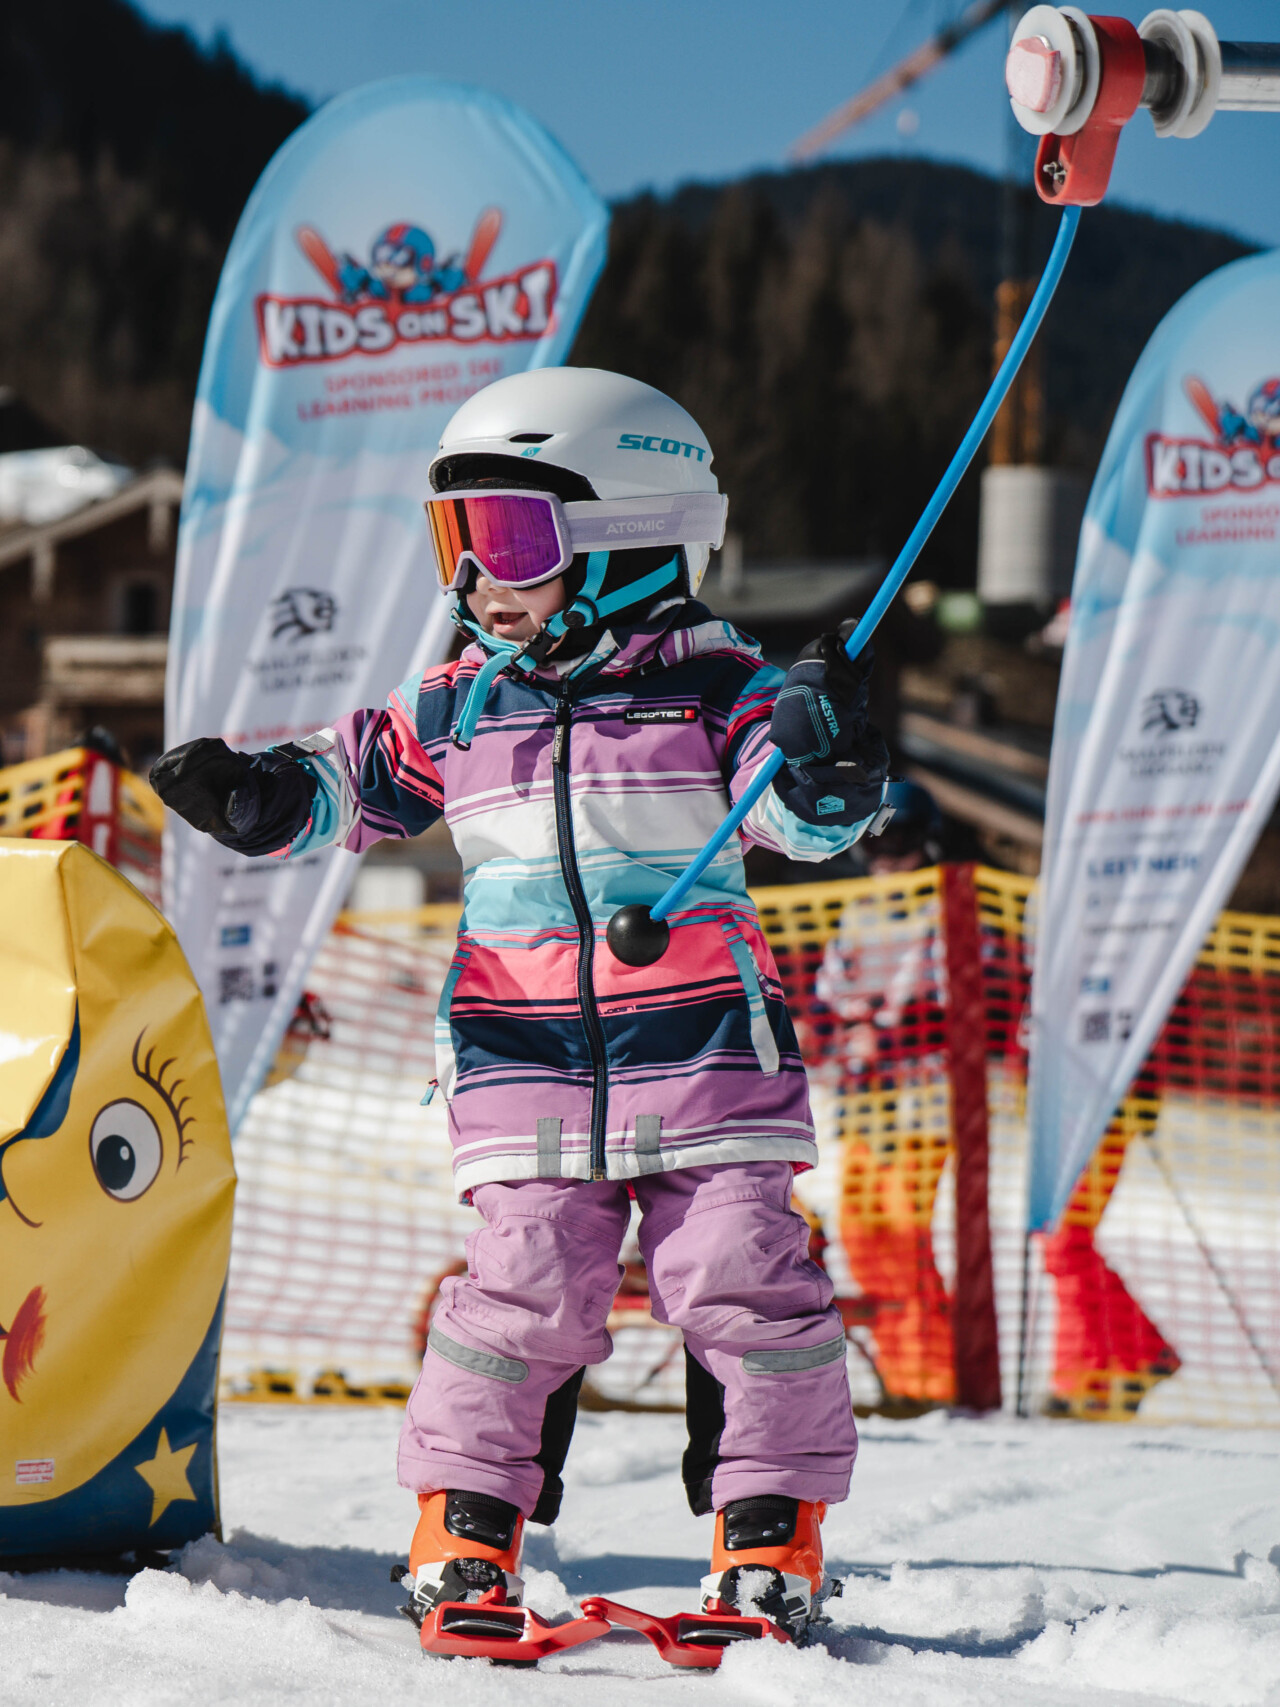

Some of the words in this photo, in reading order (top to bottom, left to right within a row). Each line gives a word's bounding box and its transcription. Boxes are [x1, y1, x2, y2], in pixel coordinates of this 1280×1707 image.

[263, 299, 395, 363] KIDS
[448, 264, 552, 337] SKI
[617, 433, 706, 462] SCOTT
[1152, 441, 1264, 491] KIDS
[606, 520, 666, 535] ATOMIC
[818, 694, 841, 738] HESTRA
